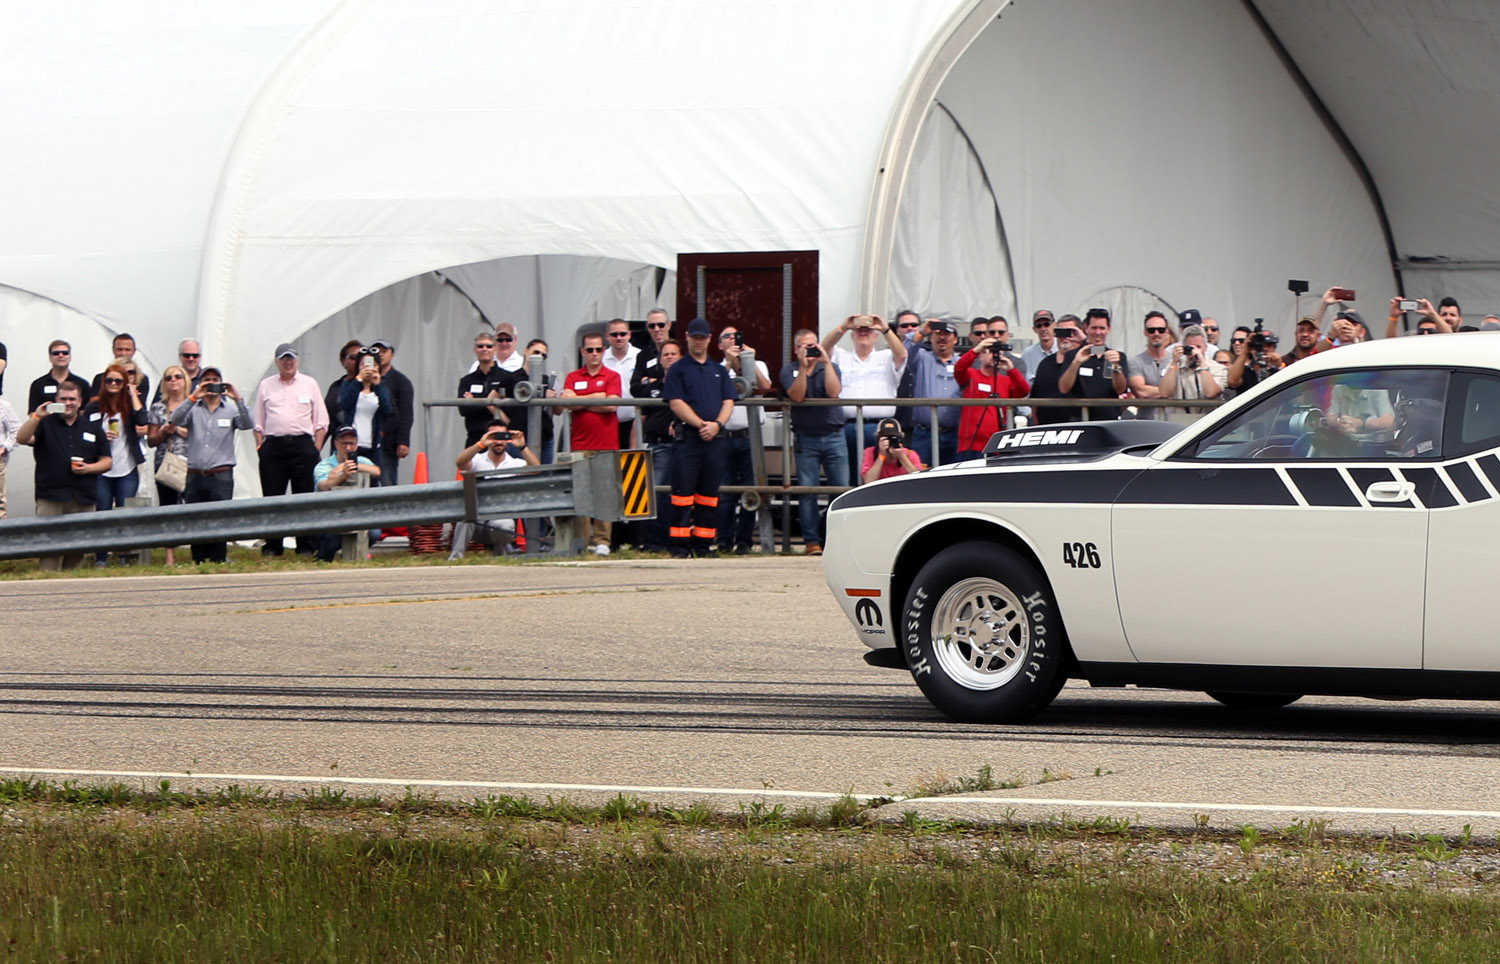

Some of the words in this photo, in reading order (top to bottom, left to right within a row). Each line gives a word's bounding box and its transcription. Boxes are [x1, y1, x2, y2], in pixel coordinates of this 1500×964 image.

[997, 430, 1084, 449] HEMI
[1063, 542, 1101, 569] 426
[906, 587, 932, 677] Hoosier
[1022, 590, 1047, 682] Hoosier
